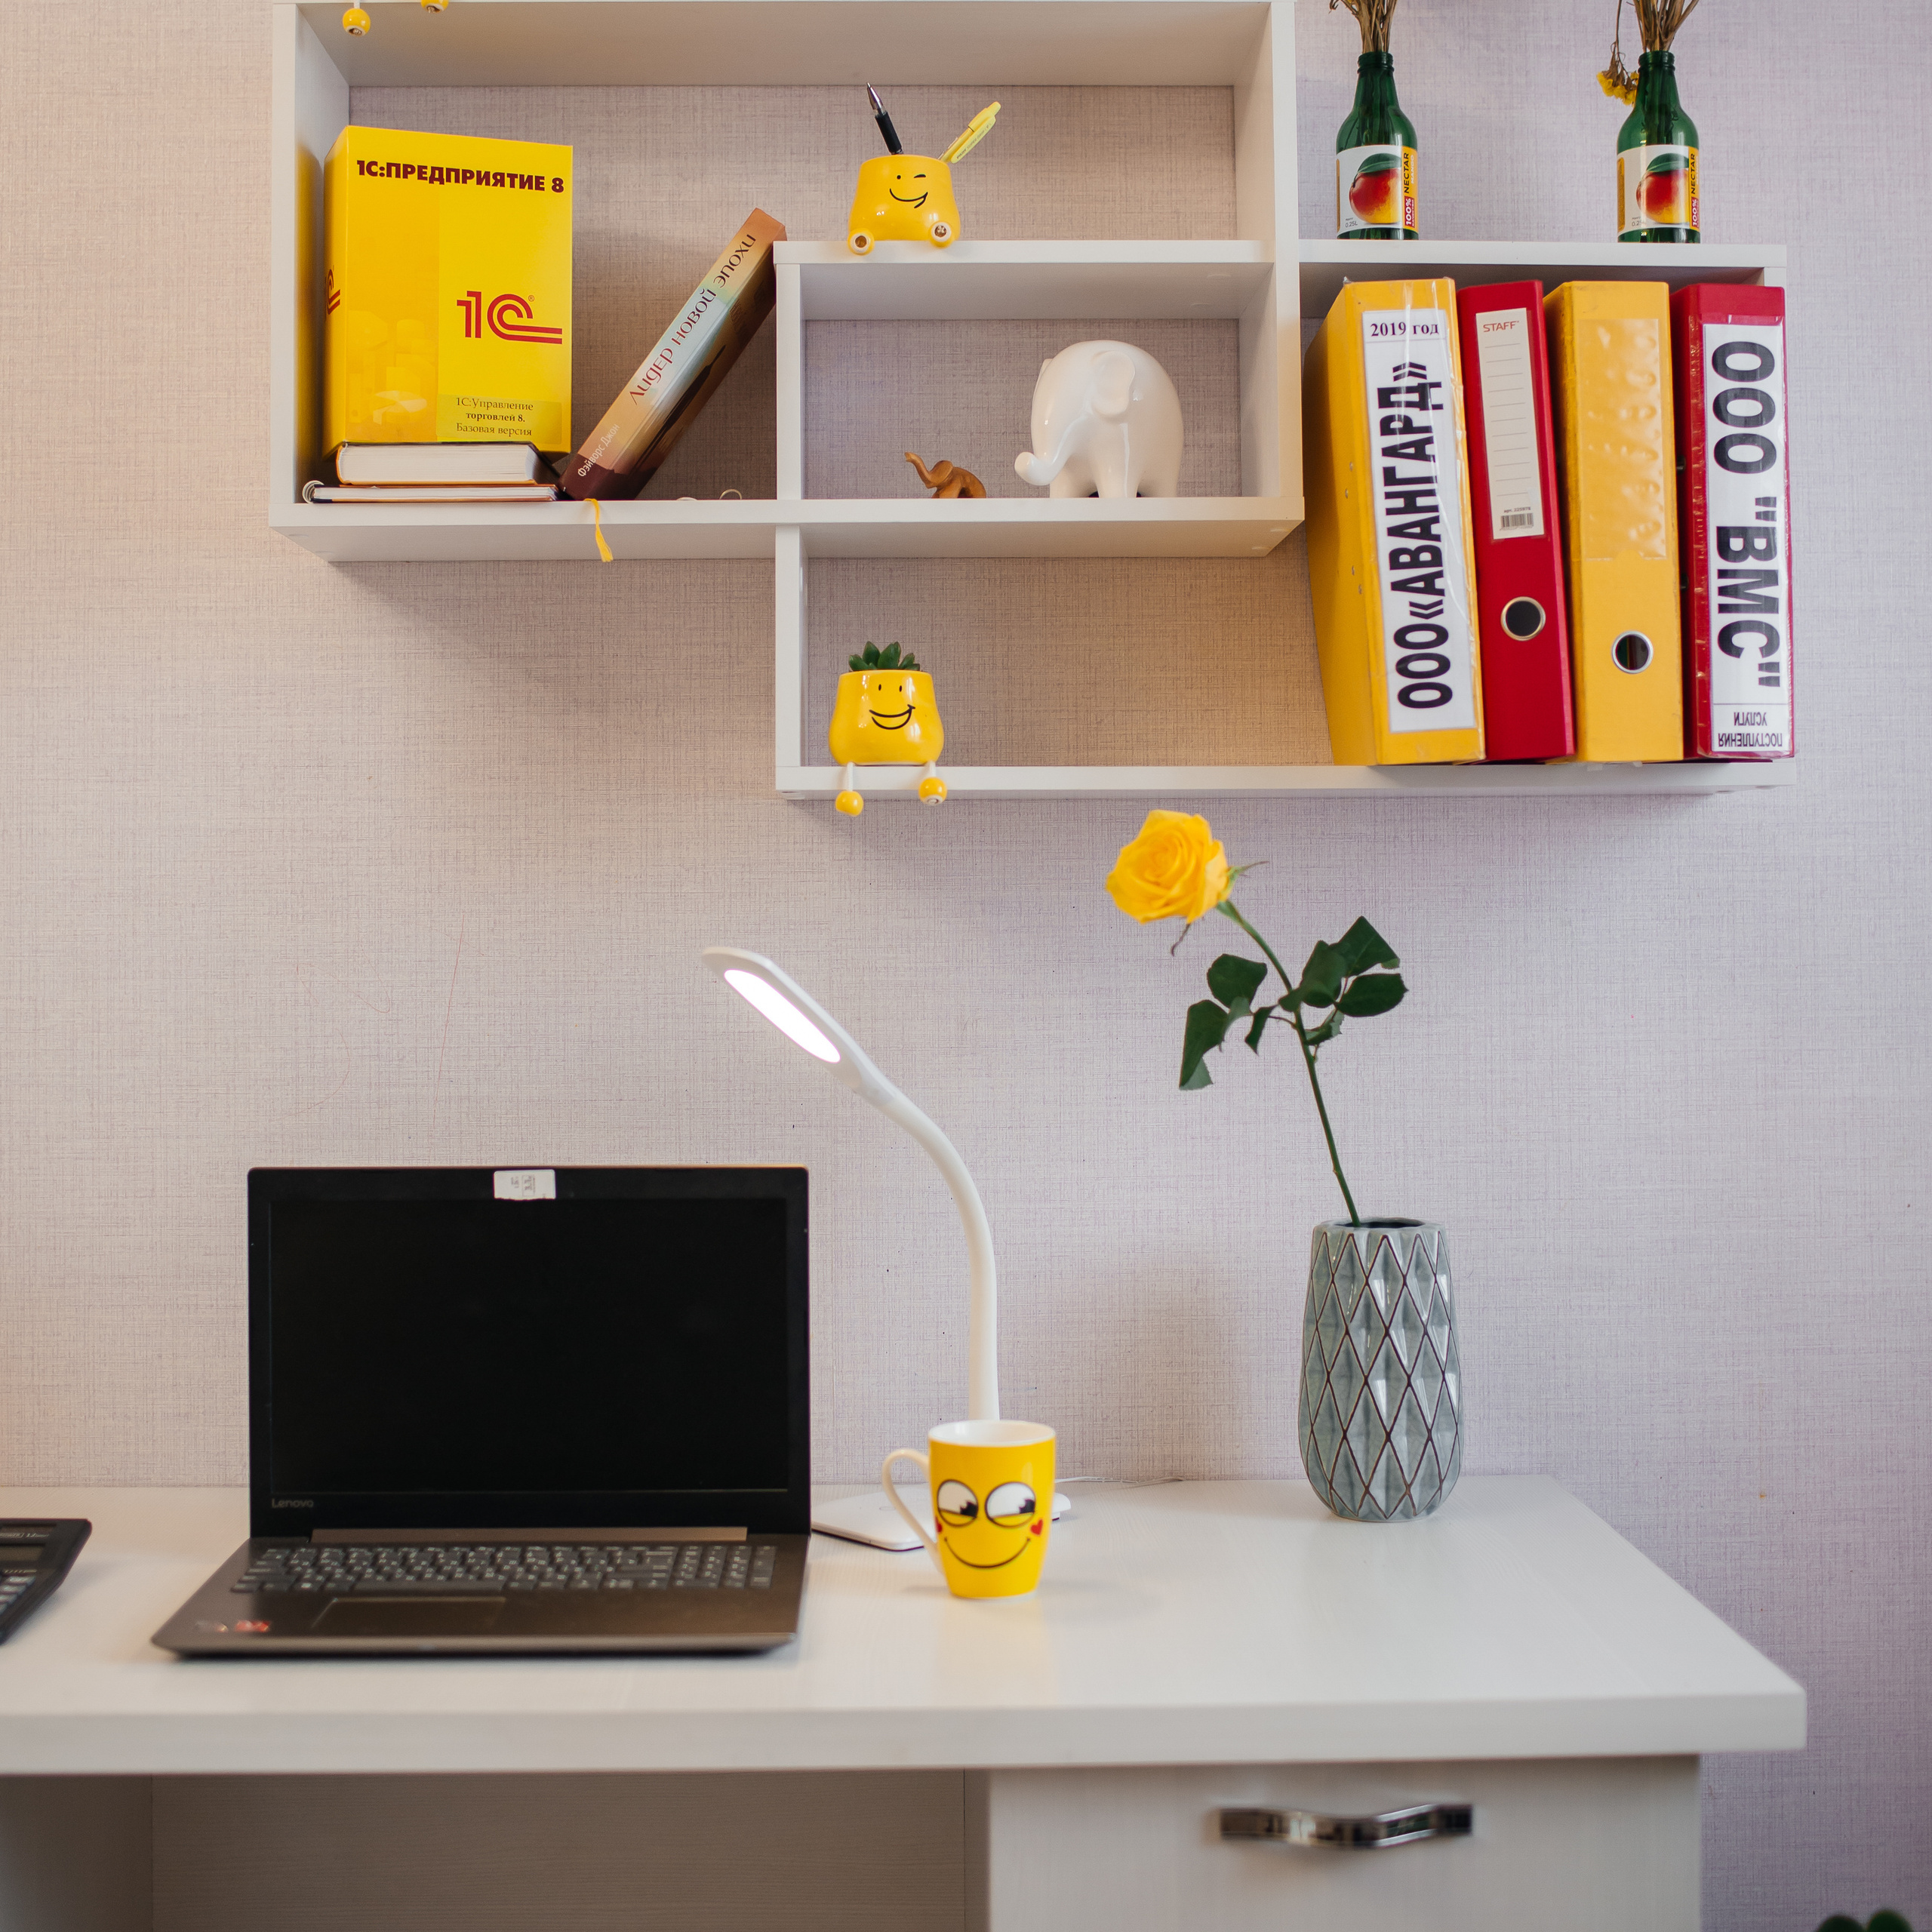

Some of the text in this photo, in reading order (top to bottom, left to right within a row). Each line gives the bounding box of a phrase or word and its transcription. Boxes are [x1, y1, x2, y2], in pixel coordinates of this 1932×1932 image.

[356, 159, 565, 193] 1С:ПРЕДПРИЯТИЕ 8
[1370, 321, 1440, 337] 2019 год
[1482, 321, 1517, 333] STAFF
[456, 396, 534, 411] 1С:Управление
[466, 412, 526, 423] торговлей 8.
[456, 422, 532, 438] Базовая версия
[577, 423, 620, 478] Фэйворс Джон
[1711, 340, 1781, 688] ООО "ВМС"
[1733, 712, 1767, 726] УСЛУГИ
[1718, 732, 1783, 747] ПОСТУПЛЕНИЯ
[272, 1498, 314, 1509] Lenovo
